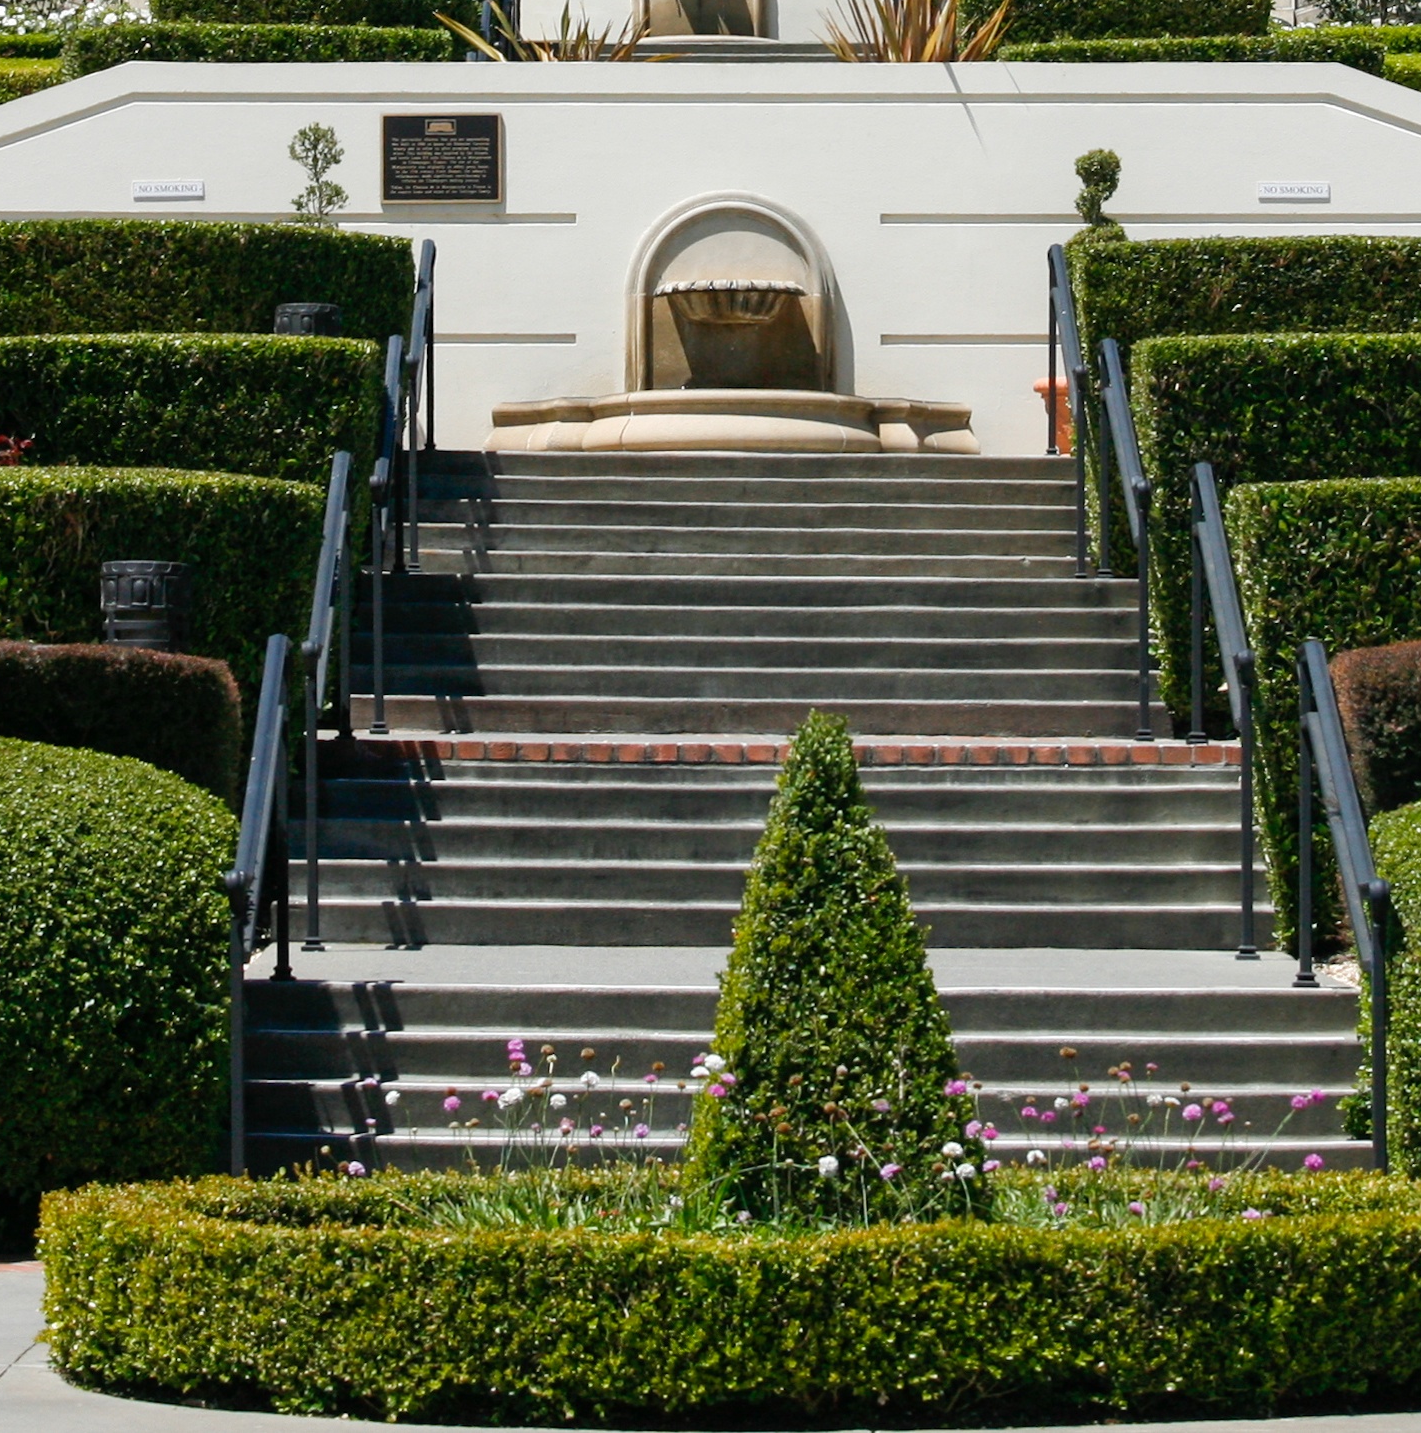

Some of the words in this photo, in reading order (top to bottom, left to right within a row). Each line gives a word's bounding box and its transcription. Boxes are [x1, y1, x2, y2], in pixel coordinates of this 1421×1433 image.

[139, 185, 153, 193] NO
[154, 184, 198, 193] SMOKING
[1263, 186, 1278, 194] NO
[1279, 186, 1323, 194] SMOKING
